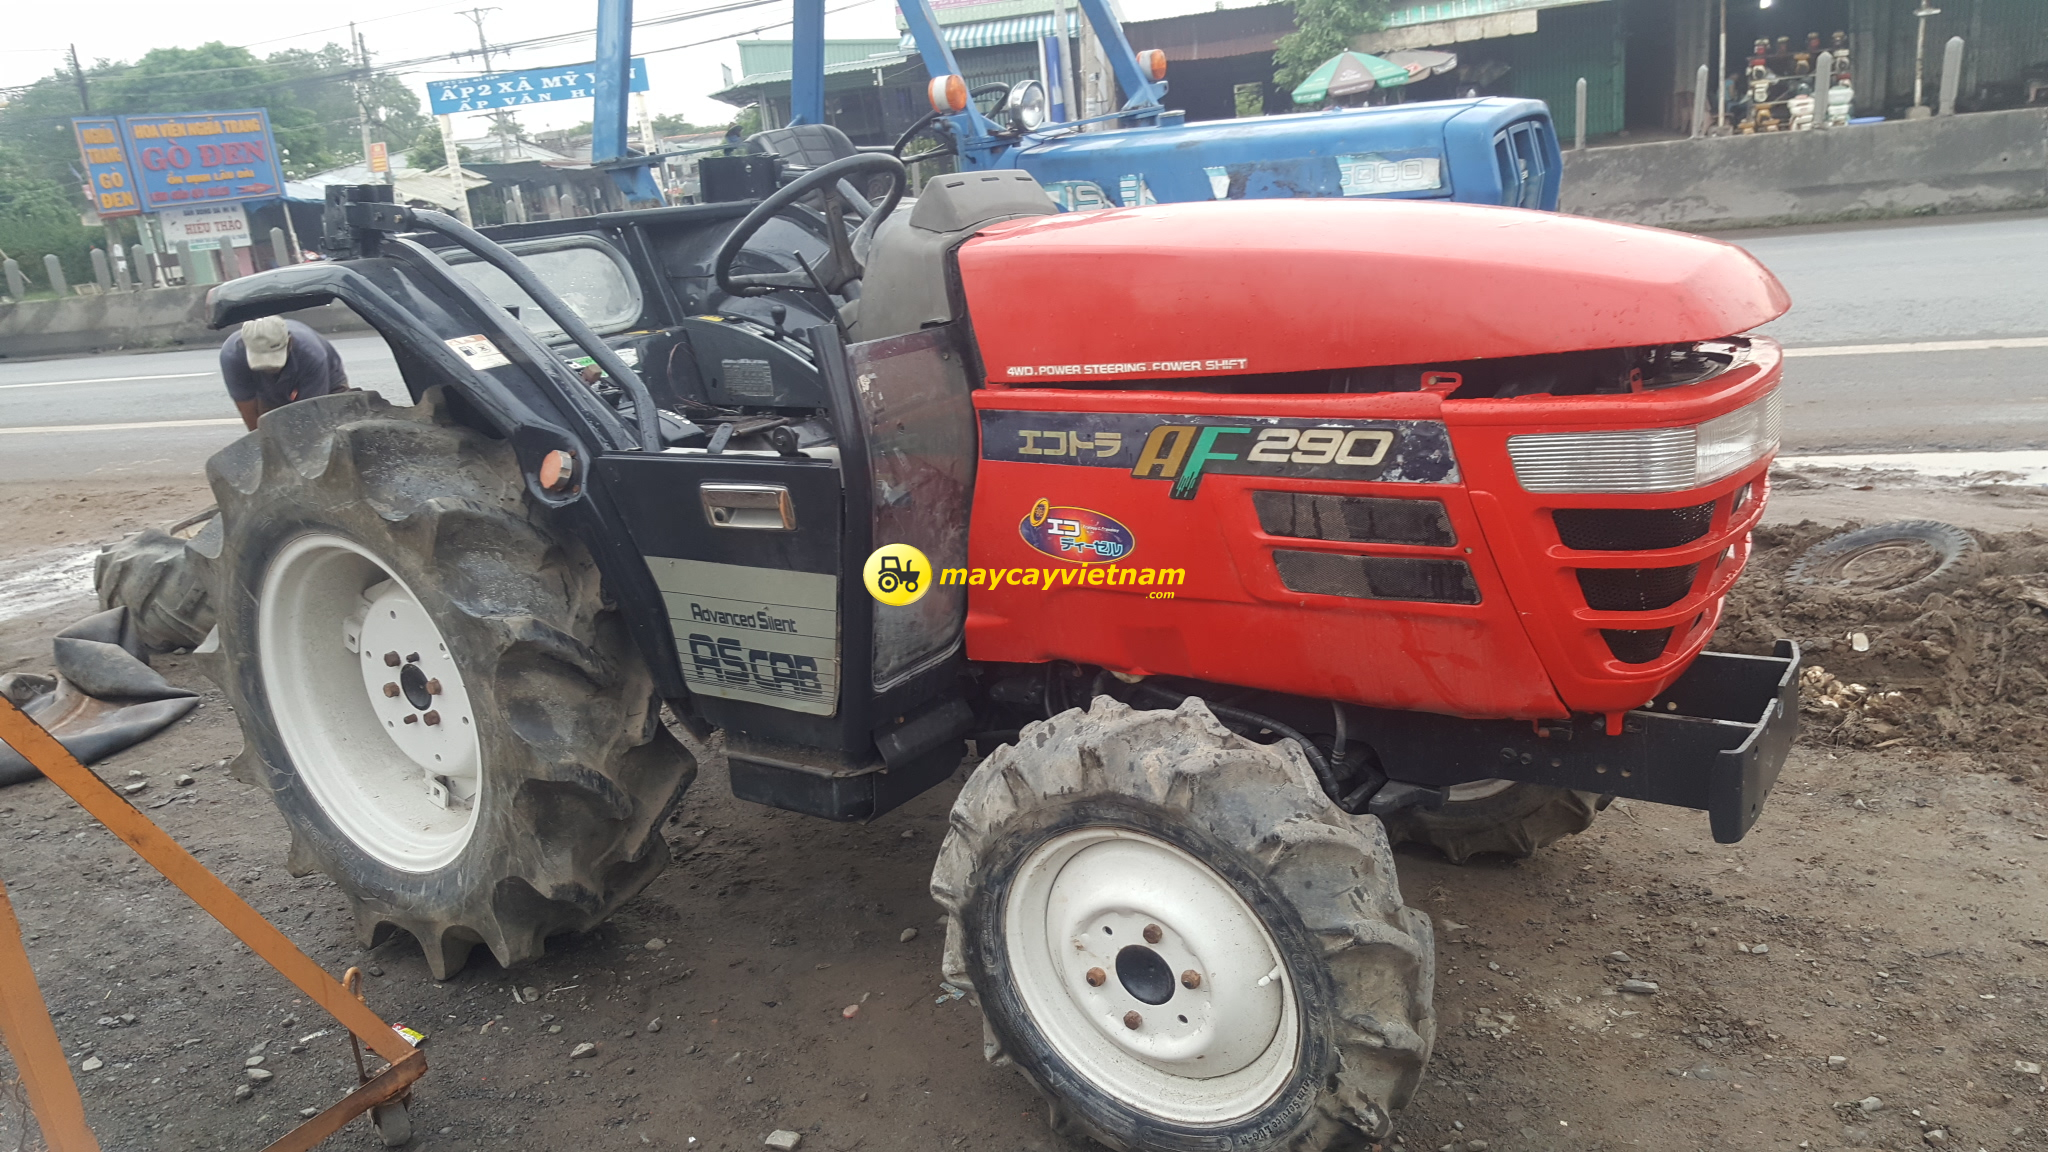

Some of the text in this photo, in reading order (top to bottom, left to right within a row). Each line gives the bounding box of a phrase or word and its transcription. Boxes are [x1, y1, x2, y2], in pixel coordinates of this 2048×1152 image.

[496, 76, 534, 93] XÃ
[458, 98, 489, 112] ẤP
[503, 92, 552, 105] VĂN
[222, 118, 261, 133] TRANG
[142, 138, 266, 171] GÒ ĐEN
[99, 166, 124, 189] GÒ
[1205, 358, 1247, 370] SHIFT
[1018, 430, 1122, 458] エコトラ
[1047, 518, 1081, 537] エコ
[1060, 537, 1124, 557] ディーゼル
[690, 602, 798, 633] Advanced Silent
